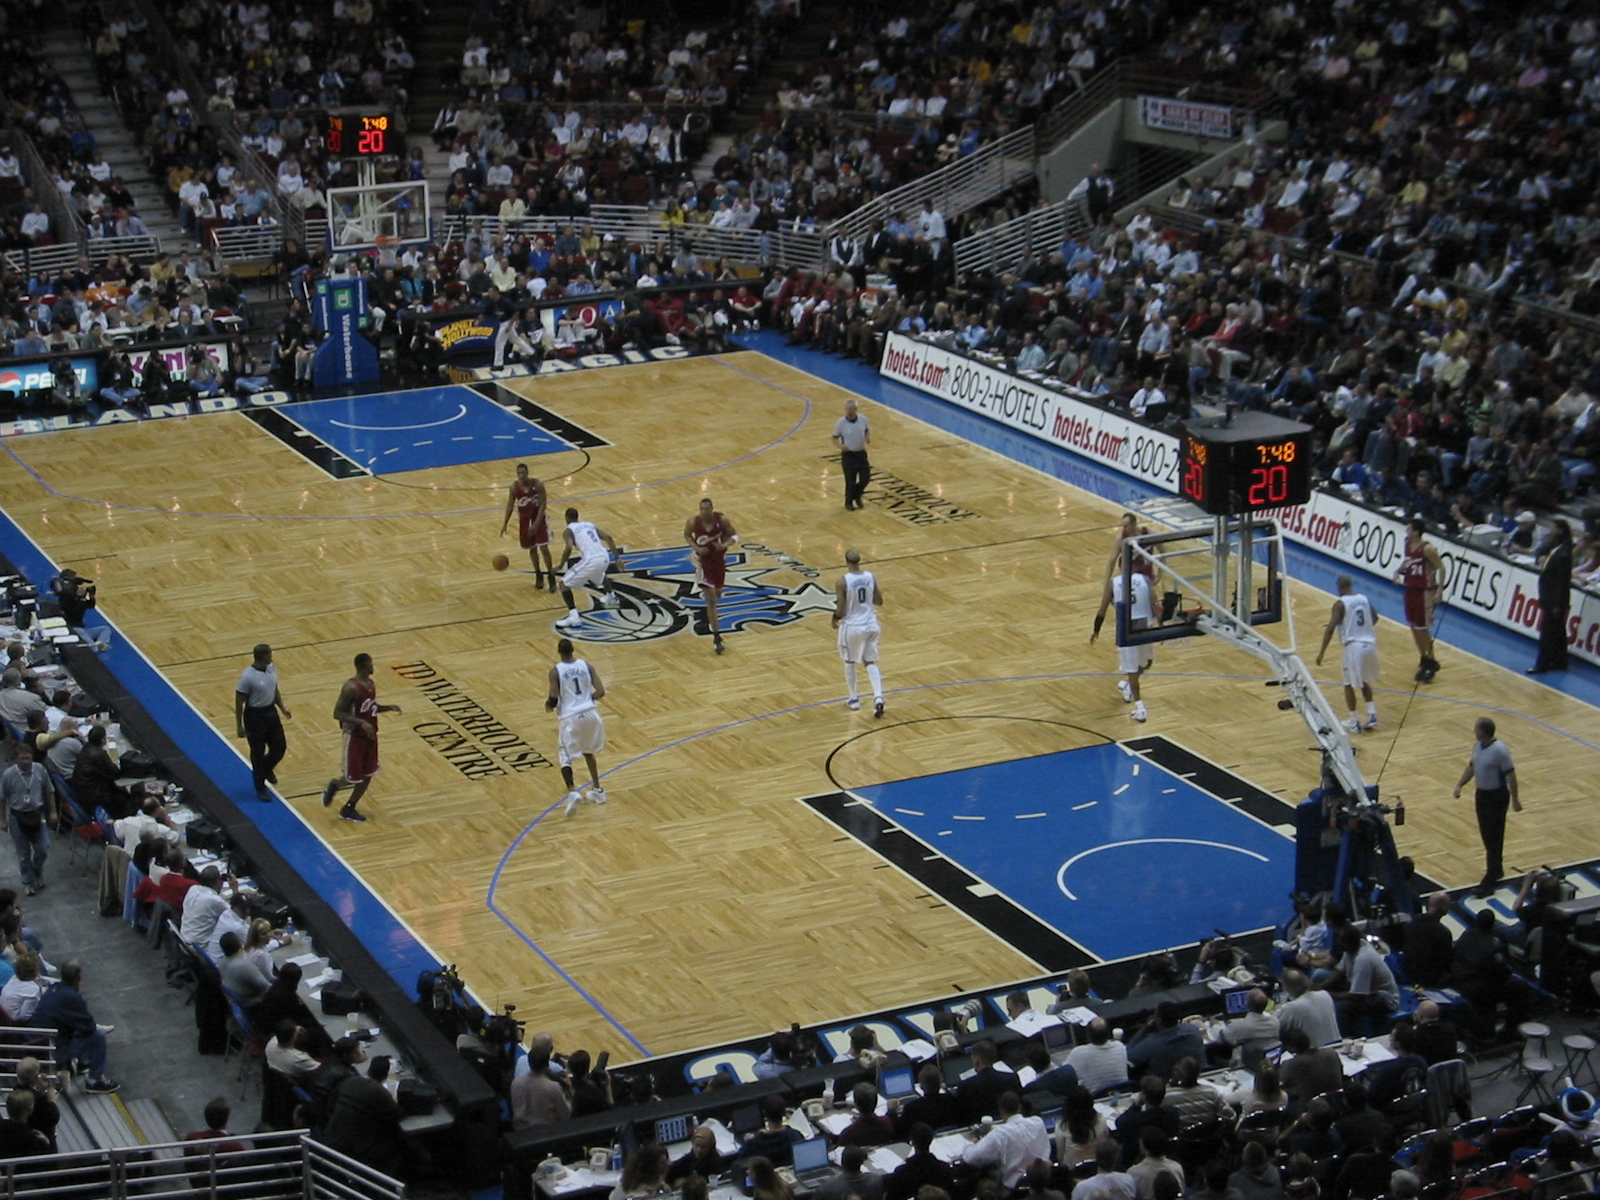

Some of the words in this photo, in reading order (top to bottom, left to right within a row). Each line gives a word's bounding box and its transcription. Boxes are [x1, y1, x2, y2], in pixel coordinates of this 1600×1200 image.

[358, 130, 386, 154] 20
[342, 314, 353, 379] Waterhouse
[885, 342, 945, 390] hotels.com
[951, 364, 1050, 431] 800-2-HOTELS
[1051, 407, 1123, 462] hotels.com
[1256, 441, 1297, 464] 7:48
[1248, 464, 1290, 505] 20
[858, 587, 866, 603] 0
[1356, 609, 1365, 626] 3
[573, 677, 582, 695] 1
[391, 660, 436, 680] TD
[414, 677, 554, 773] WATERHOUSE
[412, 721, 508, 781] CENTRE
